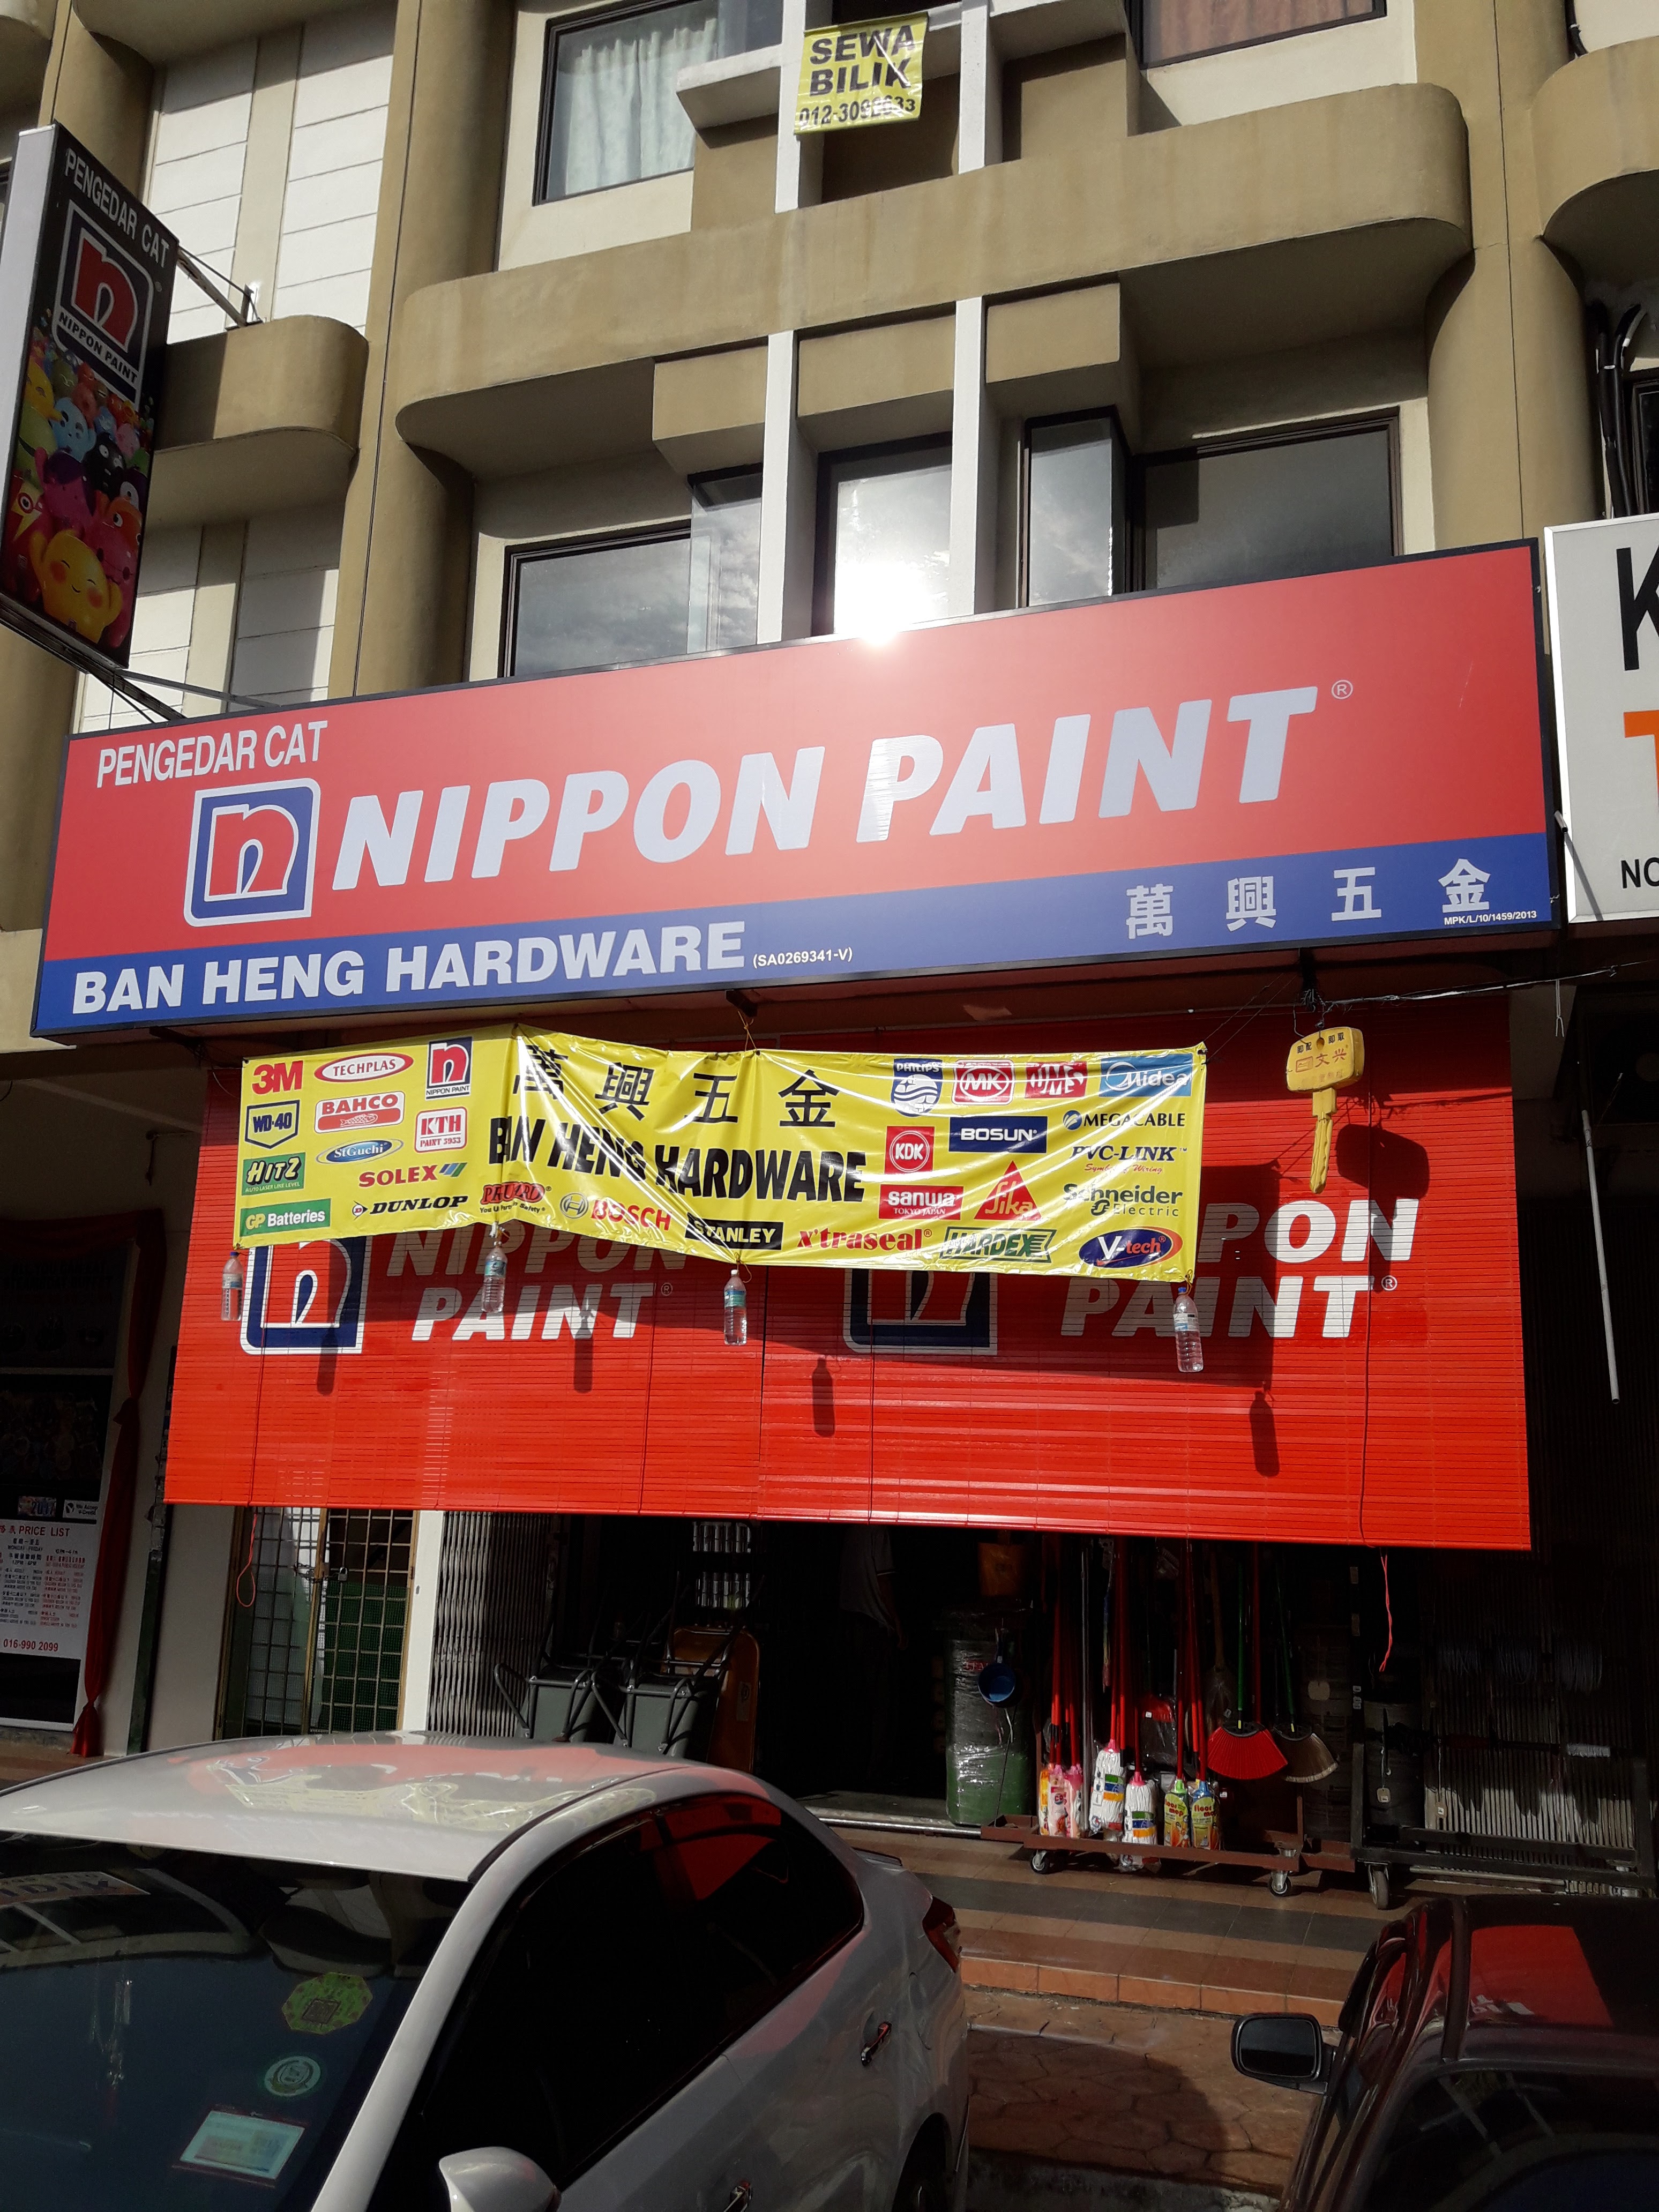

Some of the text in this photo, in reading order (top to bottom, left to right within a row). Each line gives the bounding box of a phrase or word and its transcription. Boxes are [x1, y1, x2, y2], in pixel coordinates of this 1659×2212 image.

[810, 25, 915, 64] SEWA
[810, 57, 911, 96] BILIK
[64, 147, 170, 268] PENGEDAR CAT
[59, 311, 138, 386] NIPPON PAINT
[96, 721, 328, 788] PENGEDAR CAT
[332, 685, 1318, 891] NIPPON PAINT
[1444, 909, 1538, 926] MPK/L/10/1459/2013
[72, 920, 854, 1015] BAN HENG HARDWARE (SA0269341-V)
[252, 1060, 303, 1095] 3M
[333, 1058, 397, 1078] TECHPLAS
[896, 1062, 940, 1073] PHILIPS
[964, 1073, 1003, 1090] MK
[1117, 1070, 1191, 1089] Midea
[426, 1087, 451, 1095] NIPPON
[323, 1094, 399, 1115] BAHCO
[252, 1112, 292, 1133] WD-40
[421, 1114, 461, 1135] KTH
[961, 1127, 1033, 1141] BOSUN
[547, 1122, 647, 1182] HENG
[654, 1144, 866, 1202] HARDWARE
[895, 1142, 924, 1161] KDK
[1071, 1145, 1177, 1161] PVC-LINK
[246, 1156, 302, 1186] HITZ
[358, 1164, 438, 1188] SOLEX
[370, 1195, 469, 1215] DUNLOP
[888, 1191, 955, 1207] sanwa
[245, 1209, 325, 1231] GP Batteries
[590, 1198, 673, 1231] BOSCH
[1114, 1204, 1179, 1217] Electric
[693, 1220, 776, 1244] STANLEY
[946, 1232, 1035, 1258] HARDEX
[1097, 1235, 1162, 1260] V-tech
[412, 1283, 655, 1341] PAINT
[1061, 1275, 1375, 1339] PAINT
[19, 1526, 71, 1537] PRICE LIST
[3, 1638, 59, 1652] 016-990 2099
